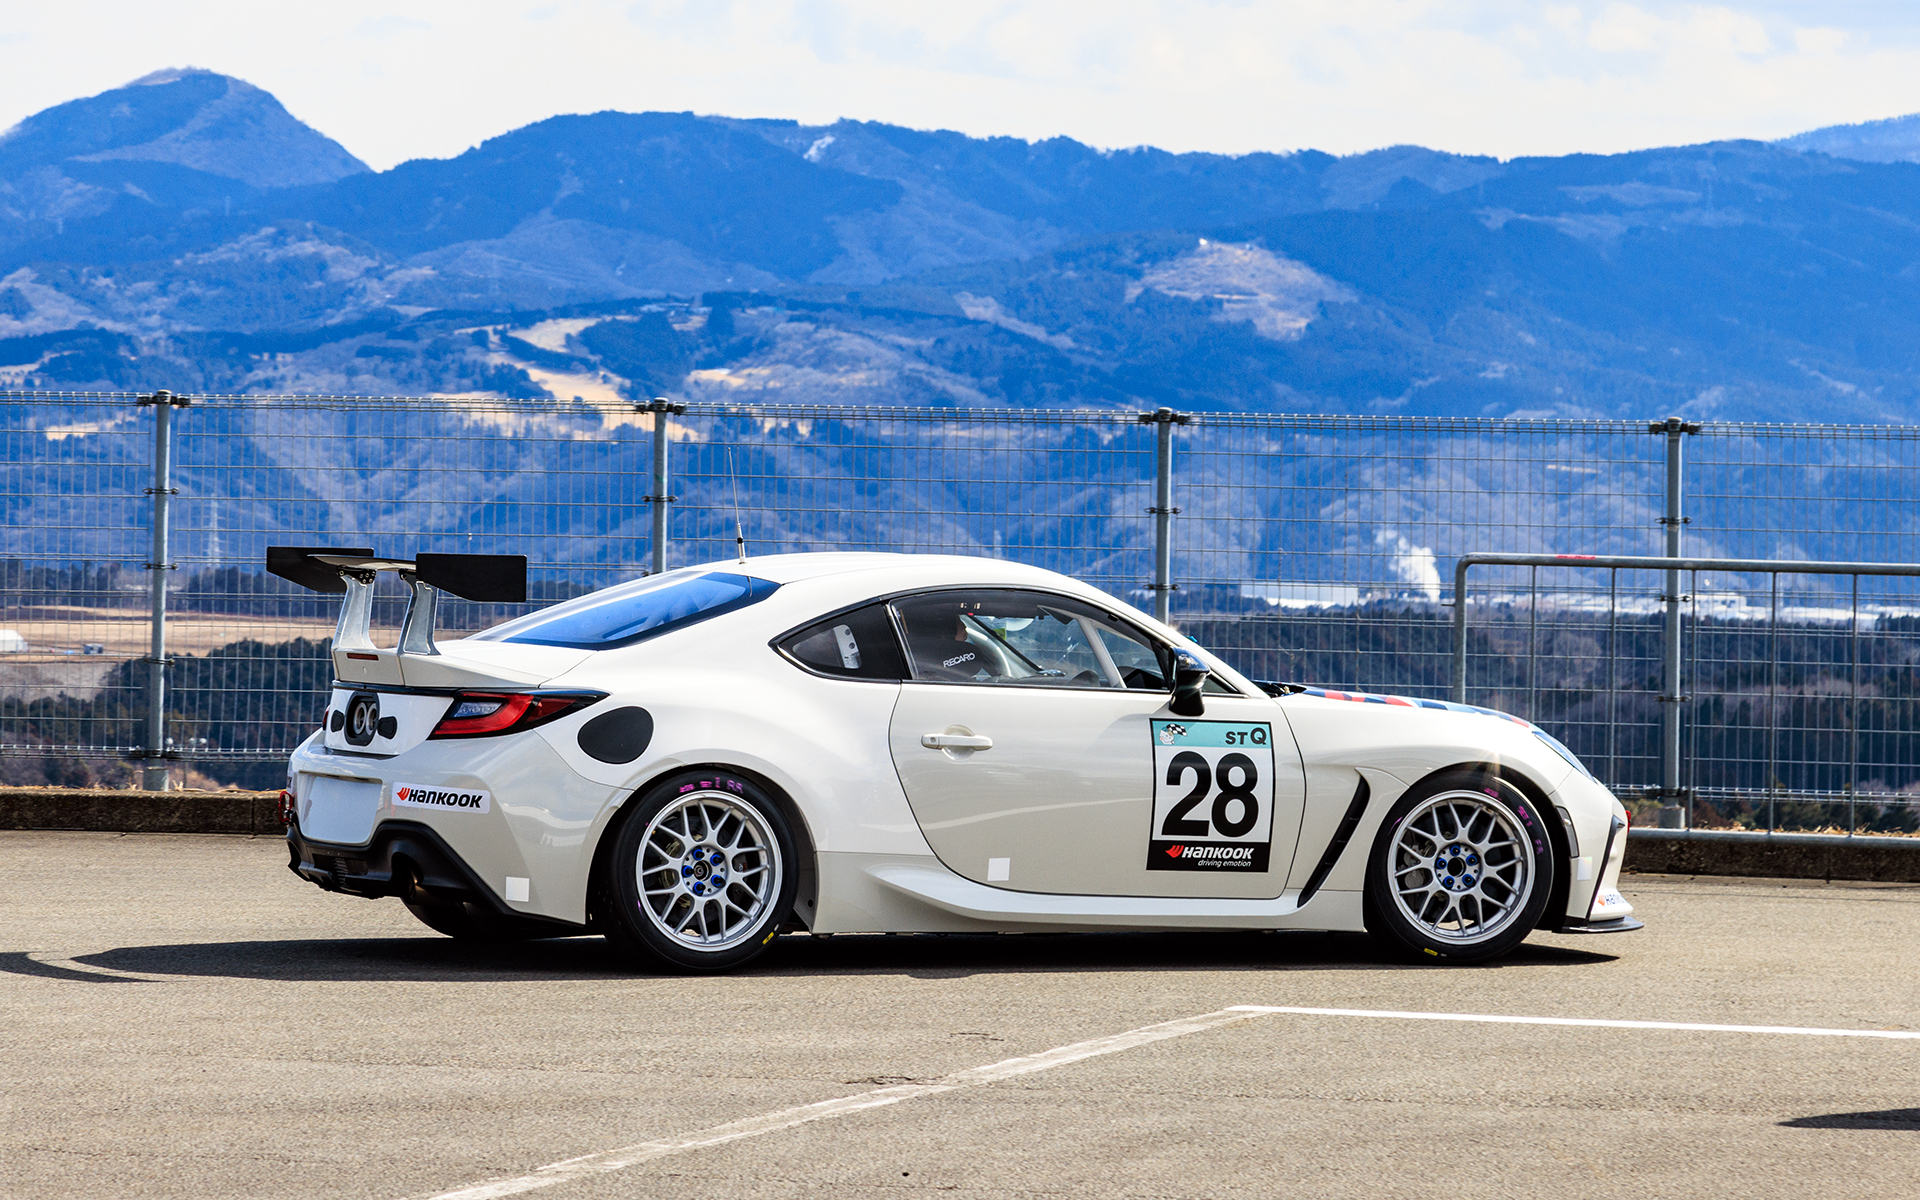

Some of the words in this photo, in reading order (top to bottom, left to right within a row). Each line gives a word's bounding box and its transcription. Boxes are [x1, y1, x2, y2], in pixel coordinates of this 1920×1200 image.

[943, 652, 975, 668] RECARO
[408, 788, 483, 809] HANKOOK
[1161, 750, 1259, 838] 28
[1182, 845, 1254, 859] HANKOOK
[1198, 859, 1222, 868] driving
[1222, 859, 1251, 867] emotion
